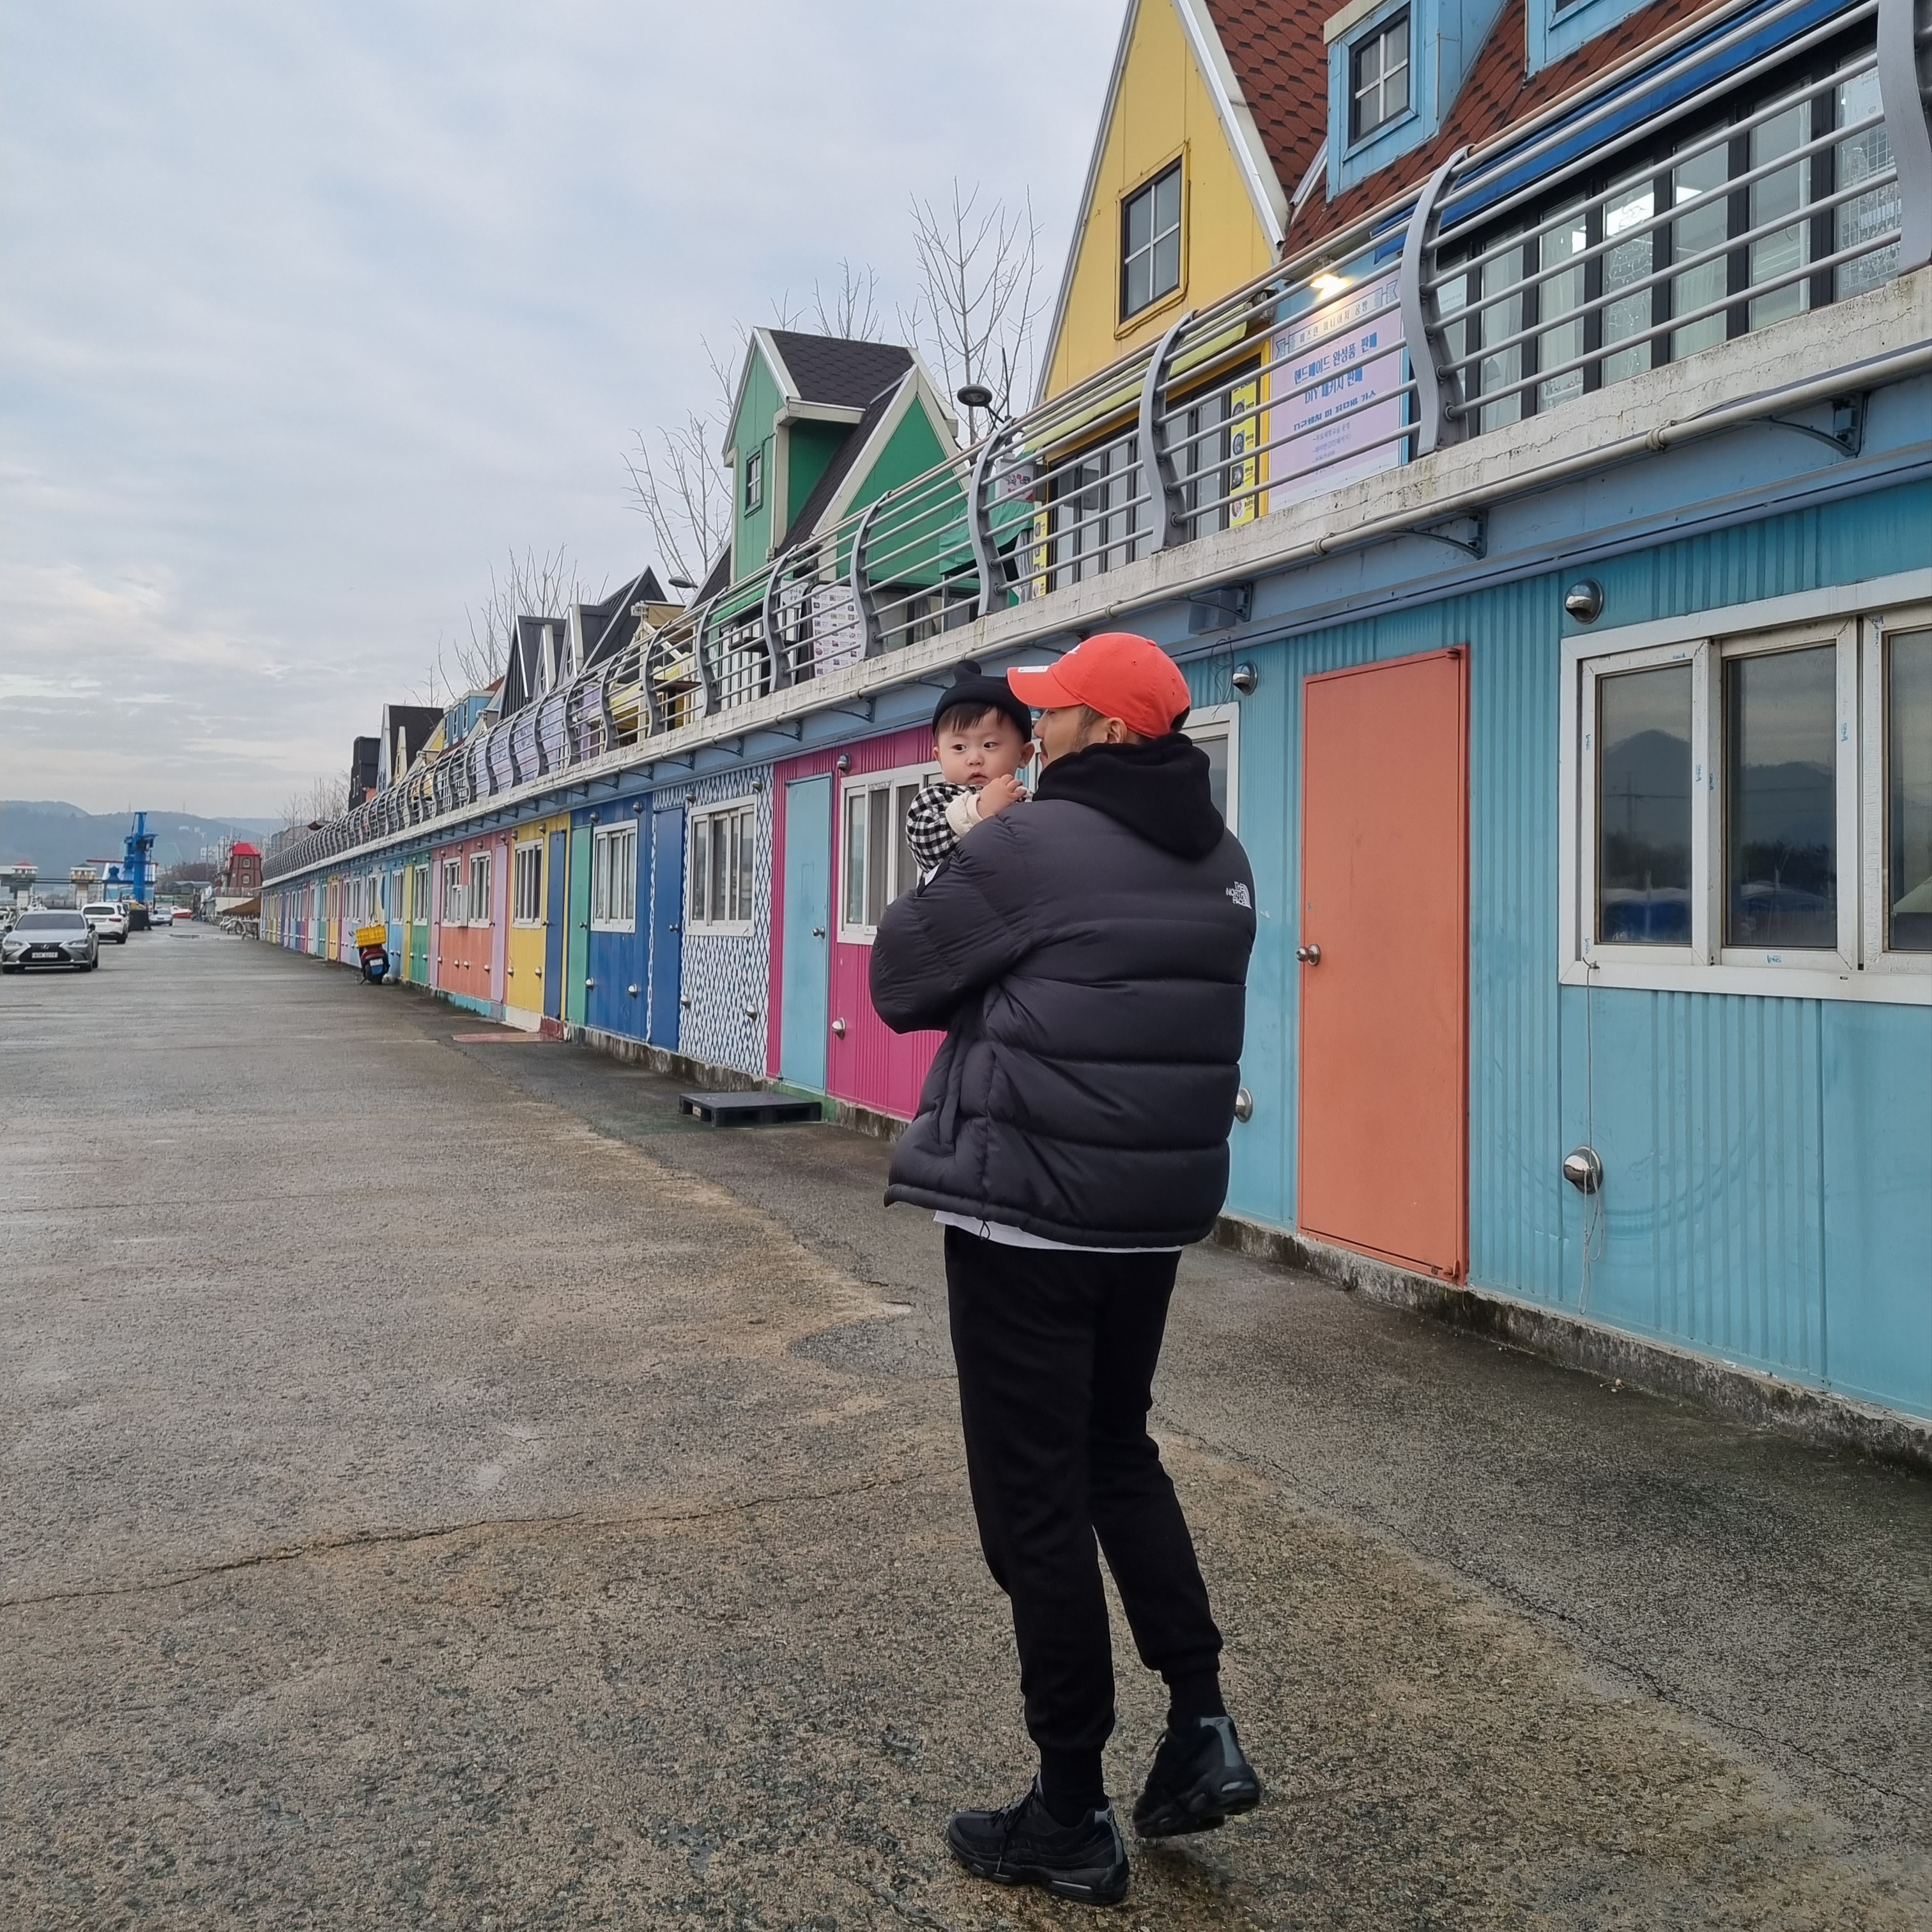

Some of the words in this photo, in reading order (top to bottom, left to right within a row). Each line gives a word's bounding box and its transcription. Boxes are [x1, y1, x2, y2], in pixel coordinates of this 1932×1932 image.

[1354, 300, 1368, 316] 공방
[1333, 342, 1356, 367] 완성품
[1361, 331, 1377, 354] 판매
[1305, 386, 1319, 404] DIY
[1225, 887, 1245, 900] NORTH
[1234, 881, 1246, 892] THE
